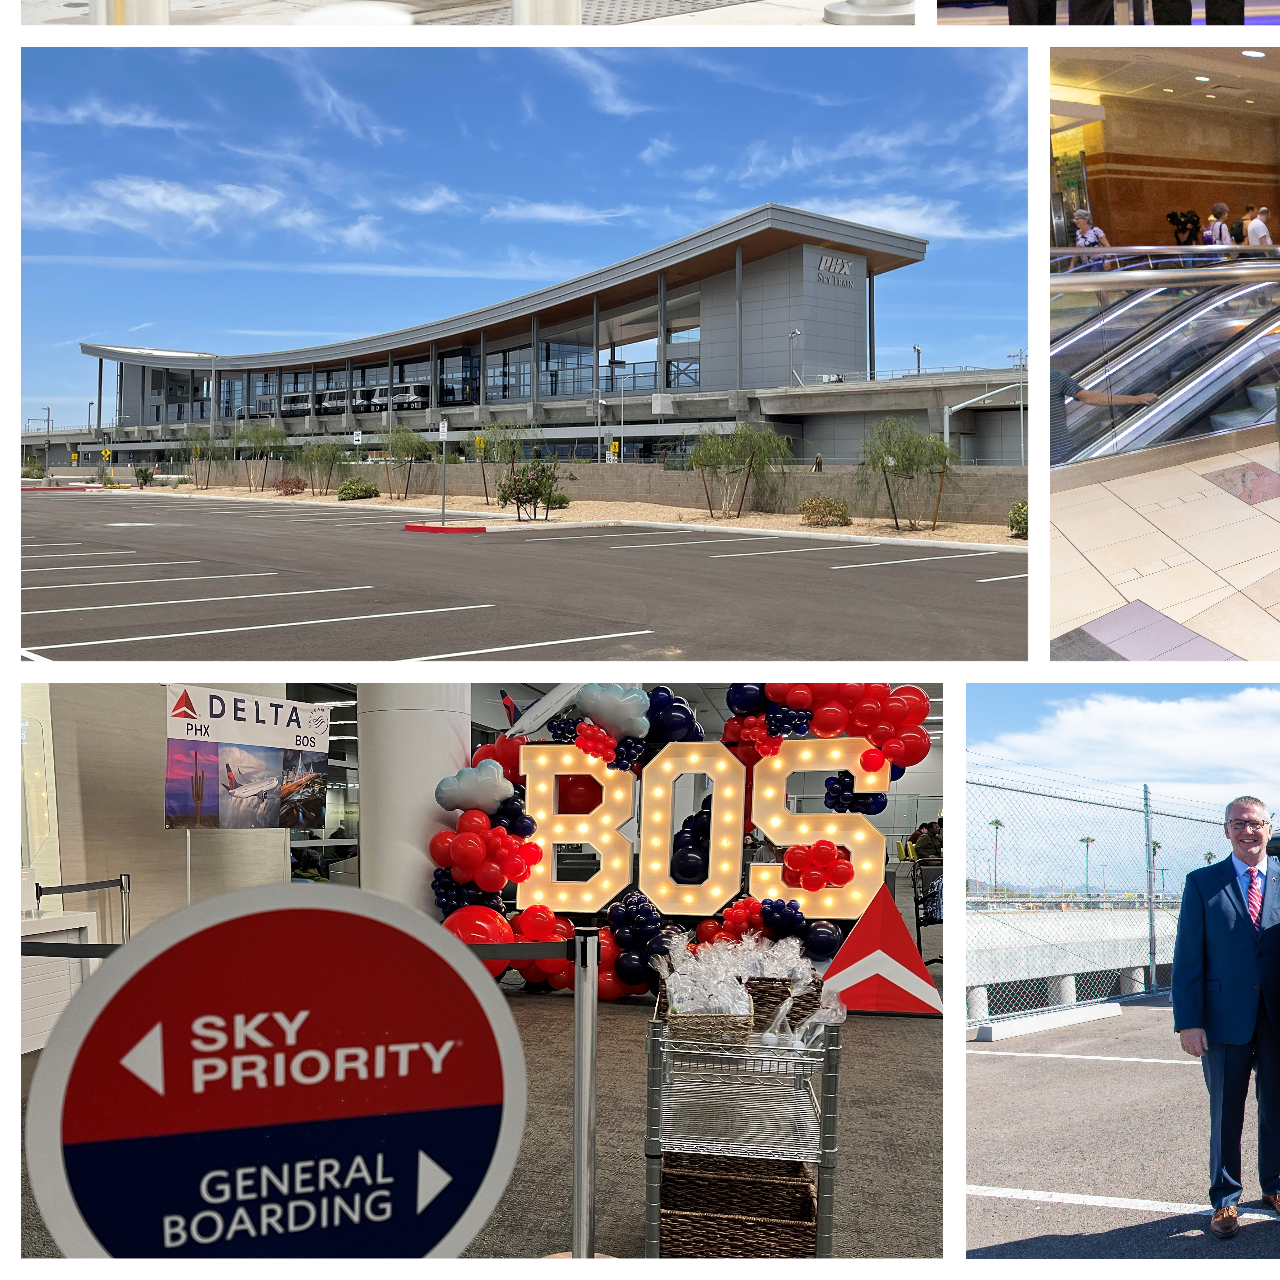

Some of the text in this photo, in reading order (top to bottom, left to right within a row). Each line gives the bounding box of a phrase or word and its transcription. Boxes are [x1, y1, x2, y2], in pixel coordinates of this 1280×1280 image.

[818, 256, 854, 276] PHX
[186, 722, 210, 737] PHX
[209, 694, 302, 728] DELTA
[296, 735, 316, 747] BOS
[516, 737, 890, 920] BOS
[190, 1010, 310, 1052] SKY
[192, 1040, 456, 1094] PRIORITY
[200, 1152, 394, 1204] GENERAL
[163, 1190, 392, 1248] BOARDING
